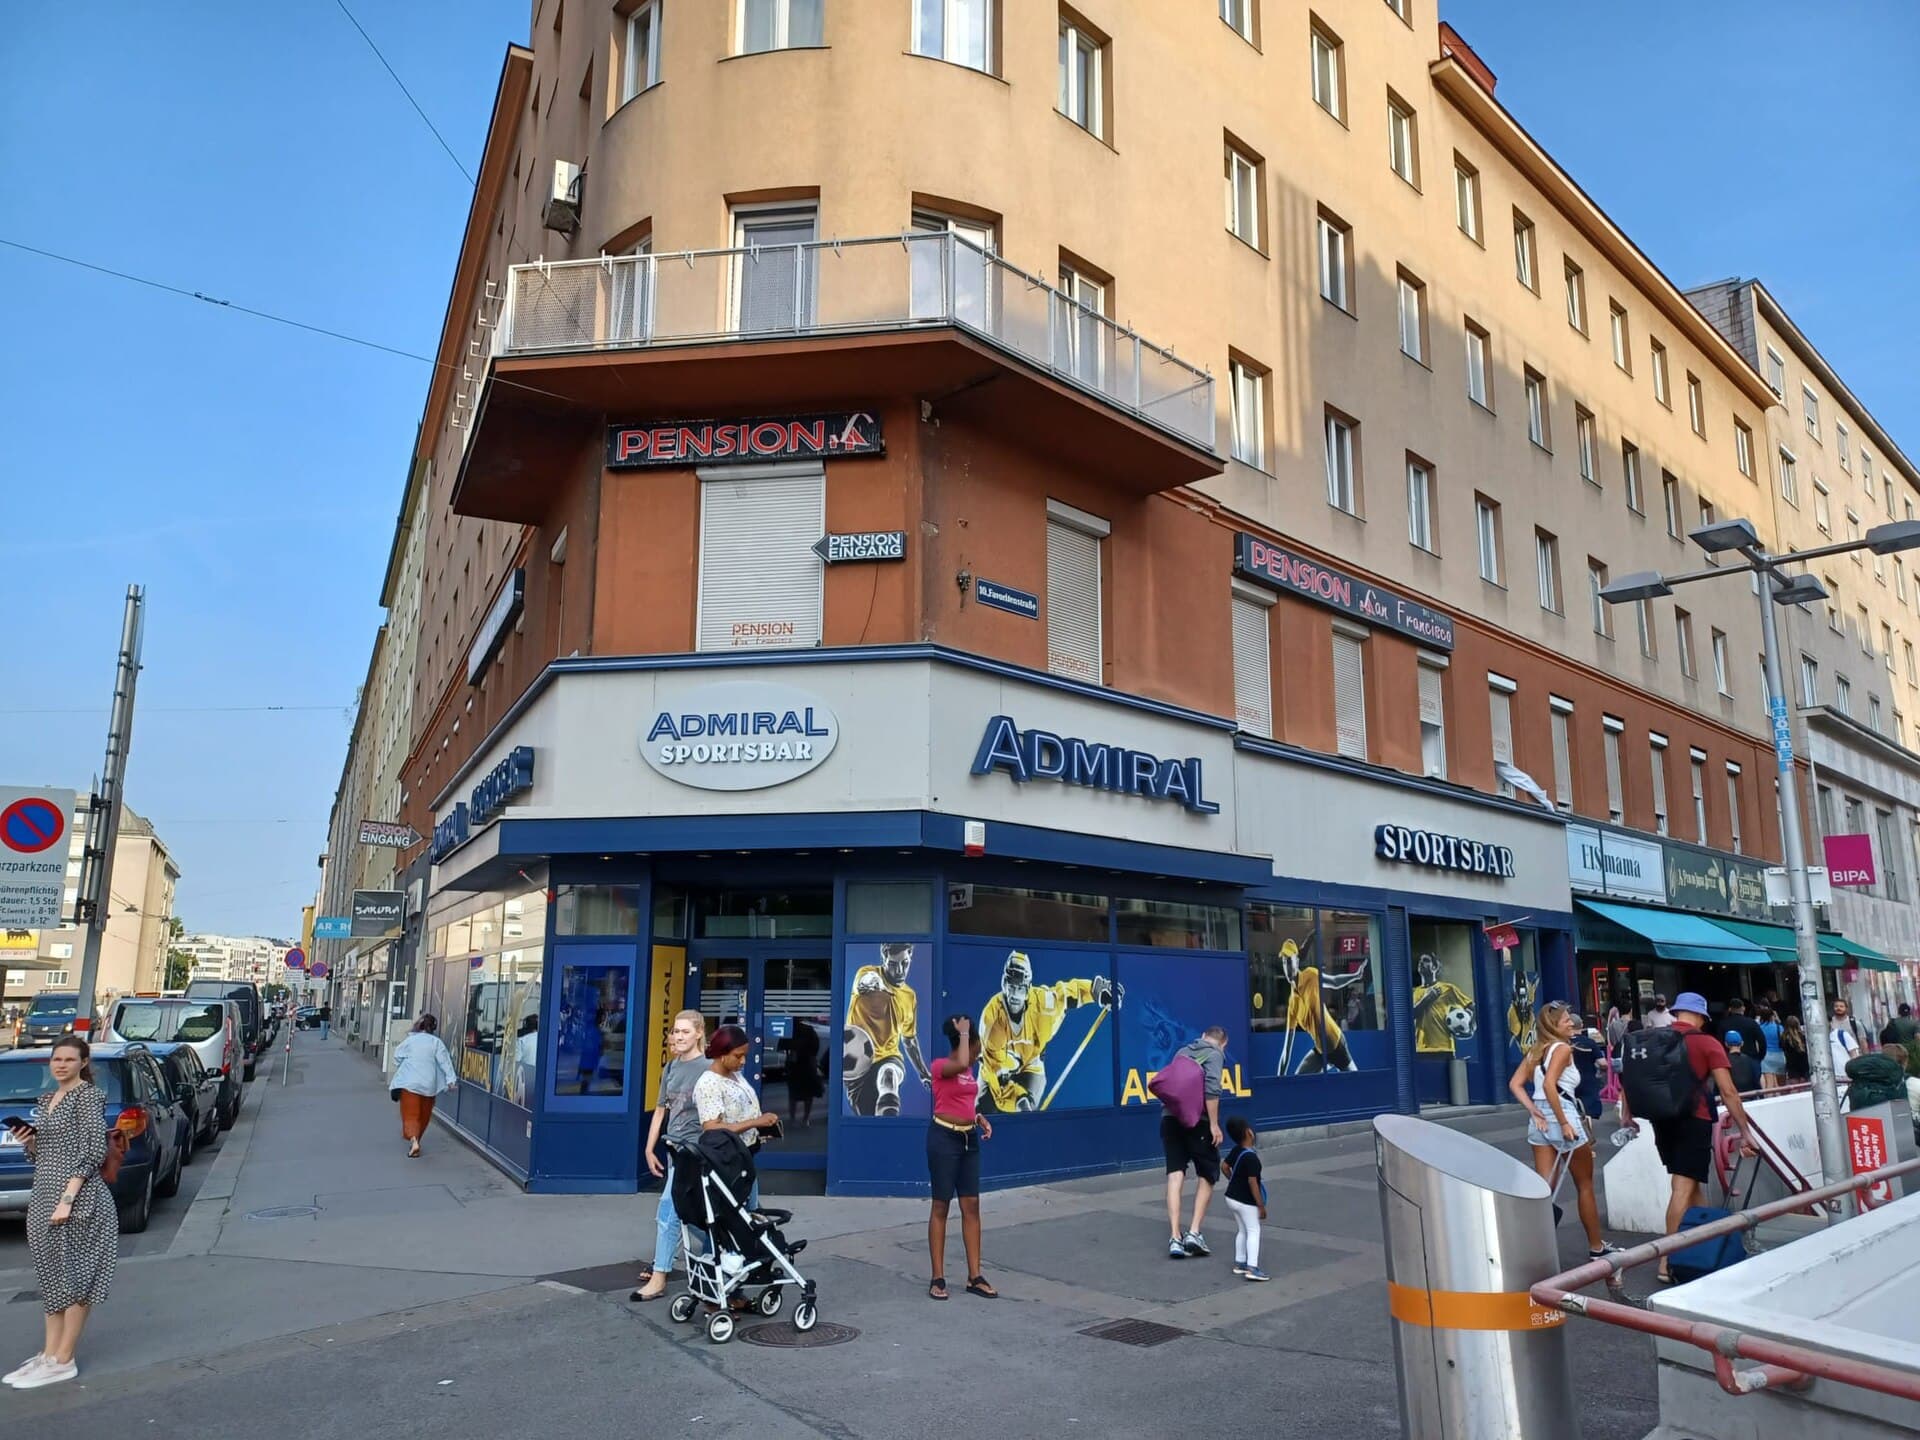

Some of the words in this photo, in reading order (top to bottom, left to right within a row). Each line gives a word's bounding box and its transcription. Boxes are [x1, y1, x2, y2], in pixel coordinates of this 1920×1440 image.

[616, 420, 826, 461] PENSION
[829, 533, 901, 547] PENSION
[828, 545, 901, 558] EINGANG
[1250, 540, 1351, 607] PENSION
[1397, 600, 1453, 643] Francisco
[732, 622, 794, 636] PENSION
[647, 706, 829, 742] ADMIRAL
[659, 741, 813, 765] SPORTSBAR
[970, 714, 1220, 815] ADMIRAL
[362, 822, 412, 838] PENSION
[360, 832, 410, 847] EINGANG
[1375, 823, 1516, 878] SPORTSBAR
[1832, 869, 1870, 883] BIPA
[43, 896, 58, 905] Std.
[355, 905, 400, 916] SAKURA
[660, 961, 673, 1083] DMIRAL
